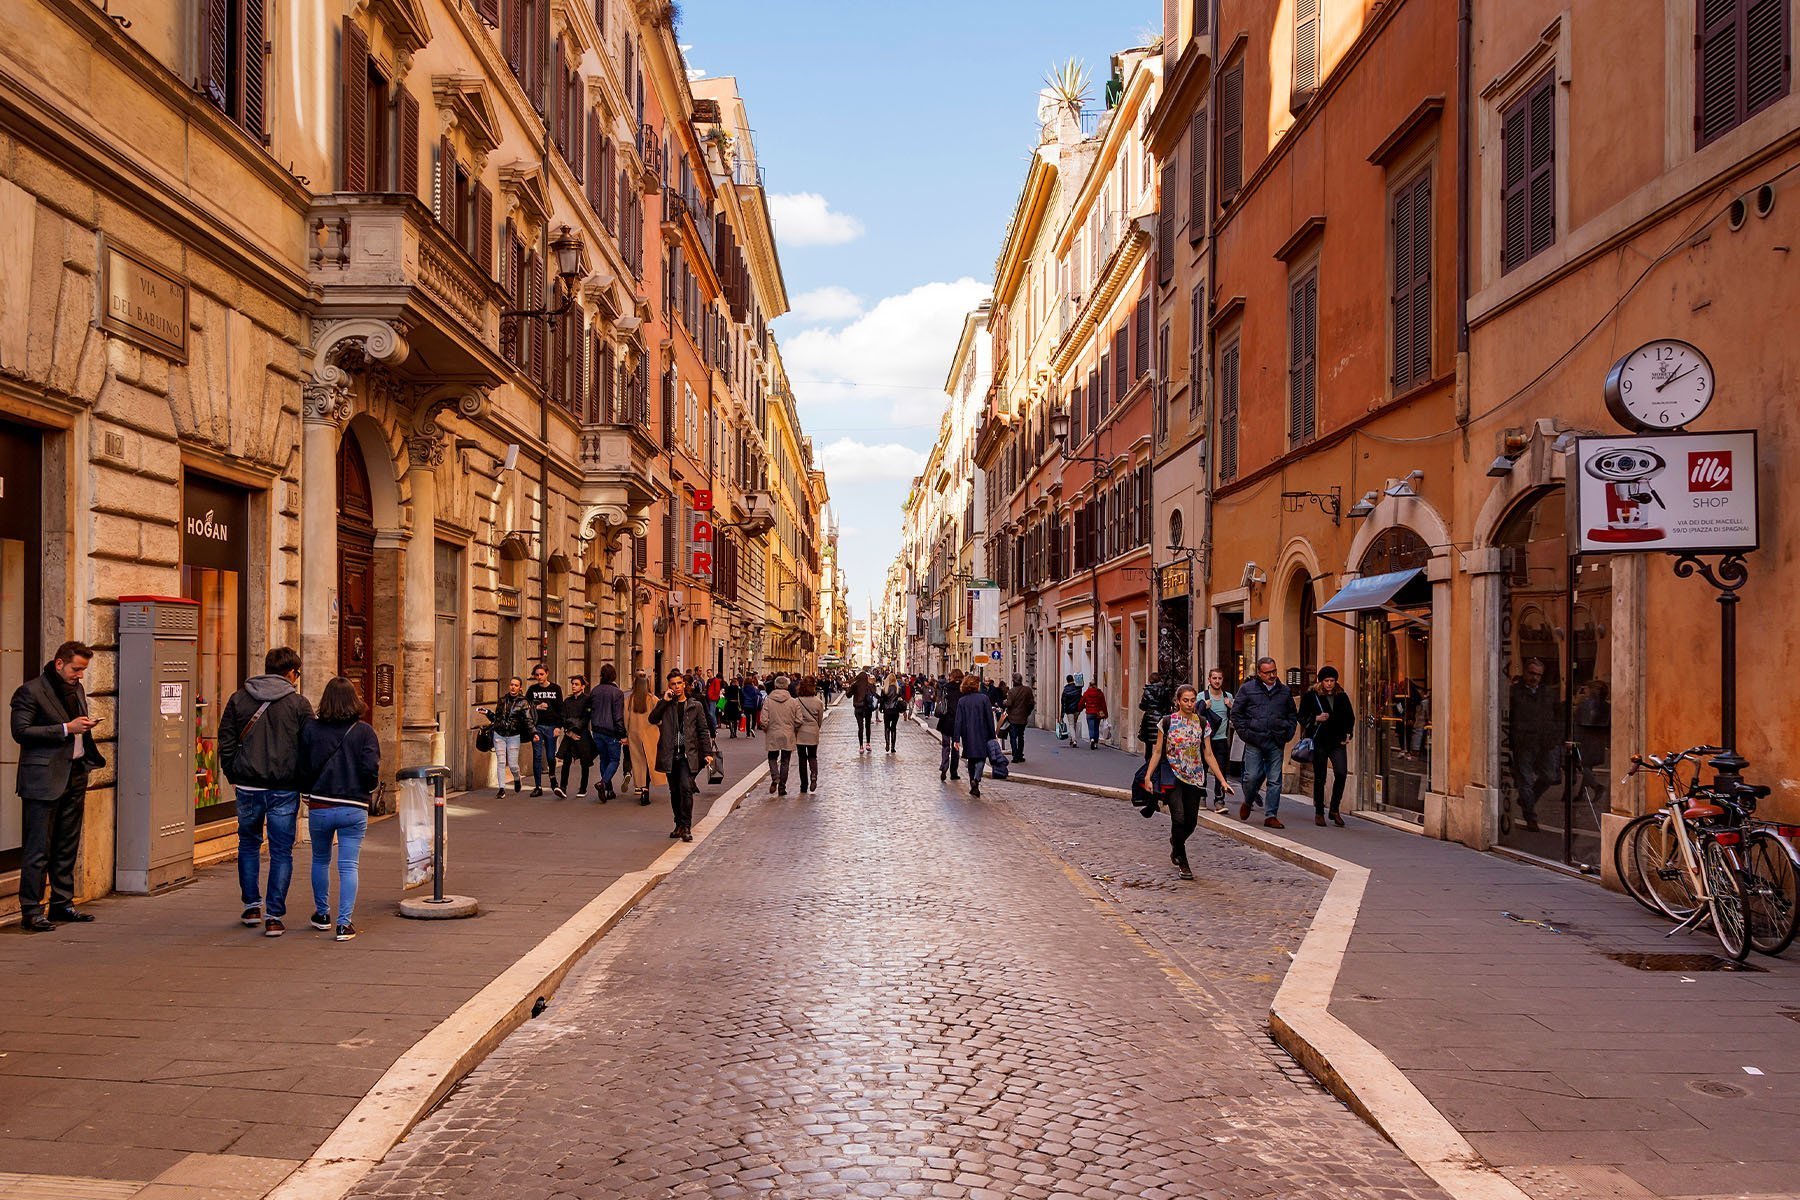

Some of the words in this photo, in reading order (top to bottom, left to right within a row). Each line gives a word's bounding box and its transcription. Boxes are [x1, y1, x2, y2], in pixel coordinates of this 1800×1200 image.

[141, 278, 156, 299] VIA
[113, 295, 133, 317] DEL
[137, 306, 180, 338] BABUINO
[1656, 346, 1674, 361] 12
[1623, 380, 1633, 394] 9
[1696, 376, 1706, 391] 3
[1659, 409, 1669, 424] 6
[107, 434, 122, 455] 112
[1691, 457, 1729, 488] illy
[288, 489, 298, 507] 113
[1692, 497, 1728, 508] SHOP
[187, 516, 228, 541] HOGAN
[693, 489, 713, 574] BAR
[533, 691, 557, 699] PYREX
